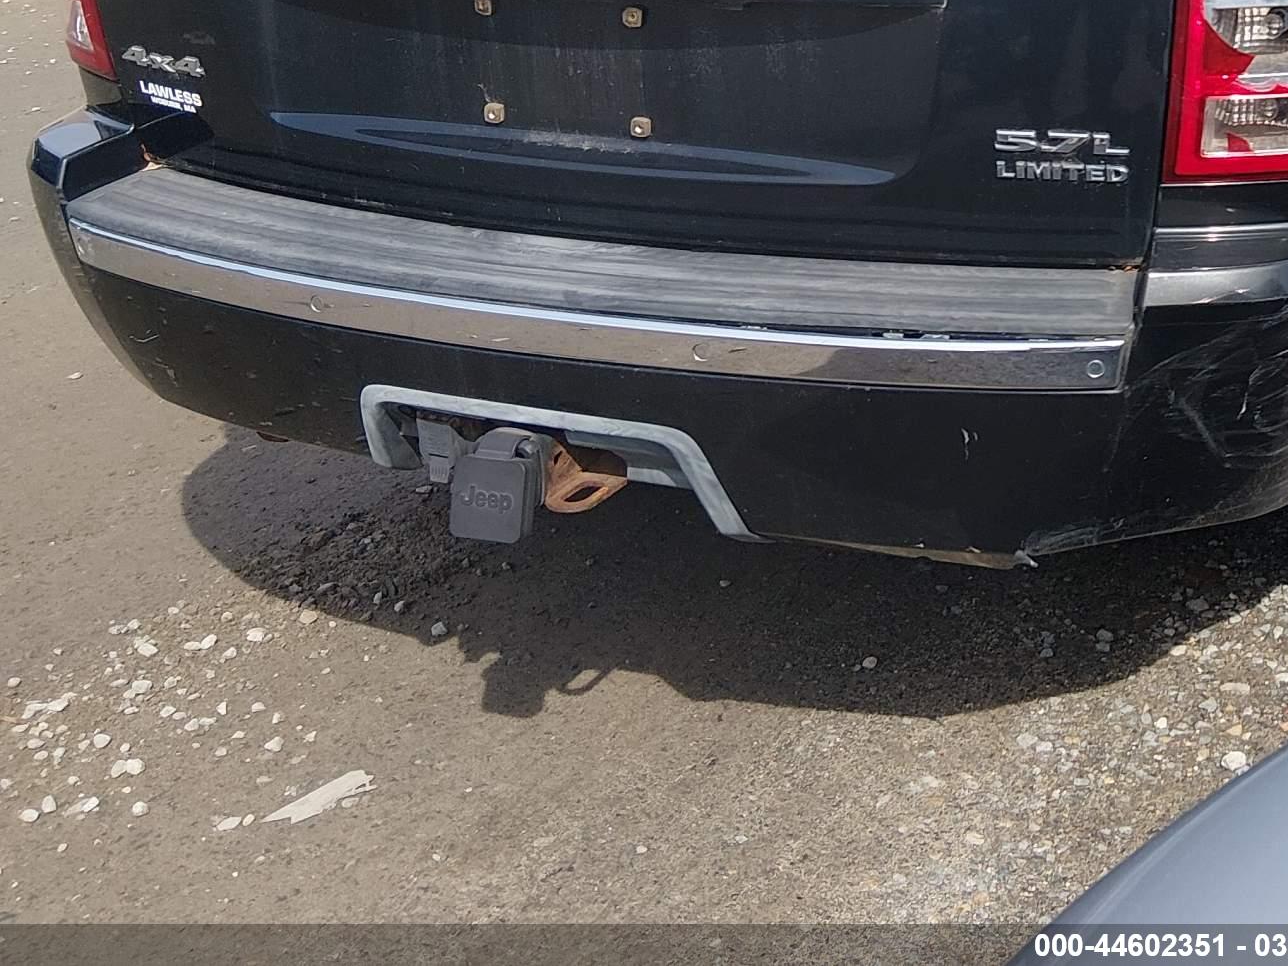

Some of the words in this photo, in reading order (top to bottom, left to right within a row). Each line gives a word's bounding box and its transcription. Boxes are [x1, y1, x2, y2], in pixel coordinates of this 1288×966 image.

[139, 80, 202, 107] LAWLESS
[183, 103, 197, 114] MA
[996, 160, 1129, 183] LIMITED
[461, 484, 514, 515] Jeep
